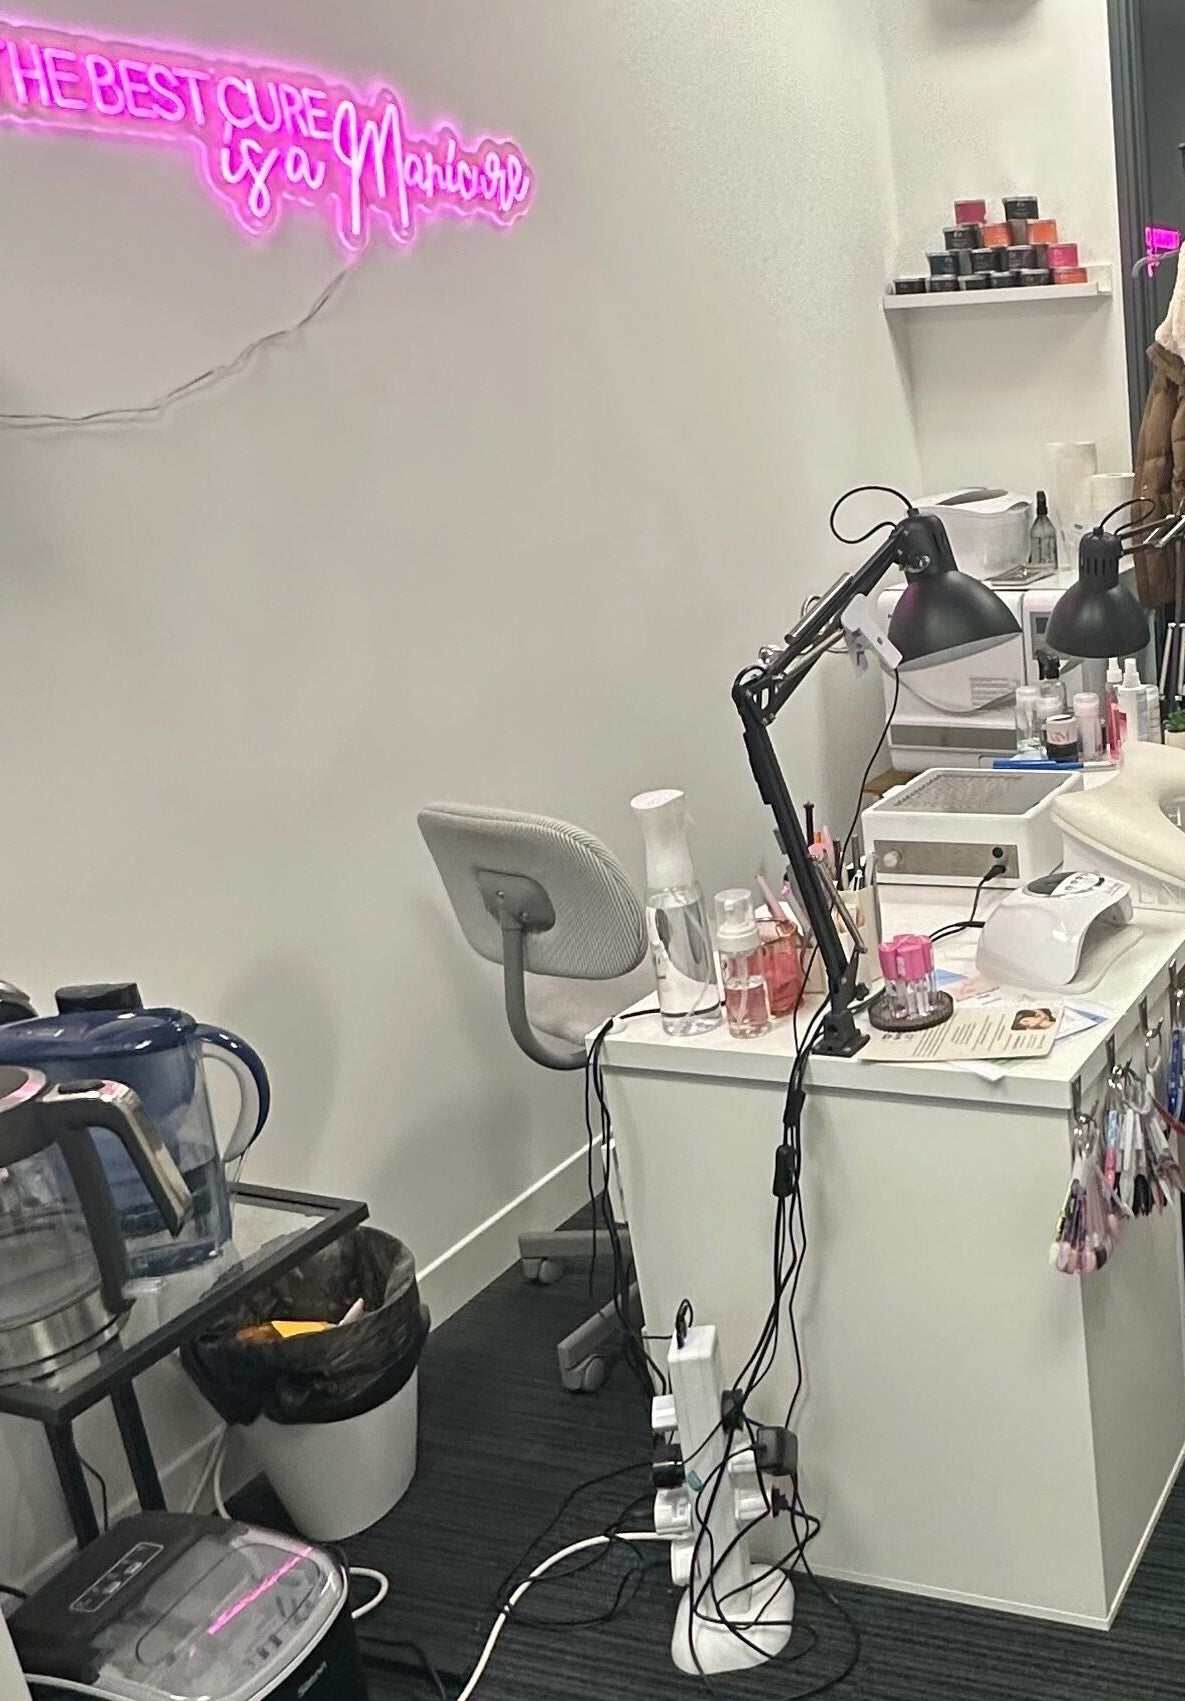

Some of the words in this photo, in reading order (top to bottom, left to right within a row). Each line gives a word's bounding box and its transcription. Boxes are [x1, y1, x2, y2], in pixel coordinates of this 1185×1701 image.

[0, 38, 88, 110] HE
[84, 53, 211, 125] BEST
[216, 76, 333, 141] CURE
[220, 119, 281, 218] is
[285, 145, 327, 190] a
[331, 99, 530, 236] Manicure
